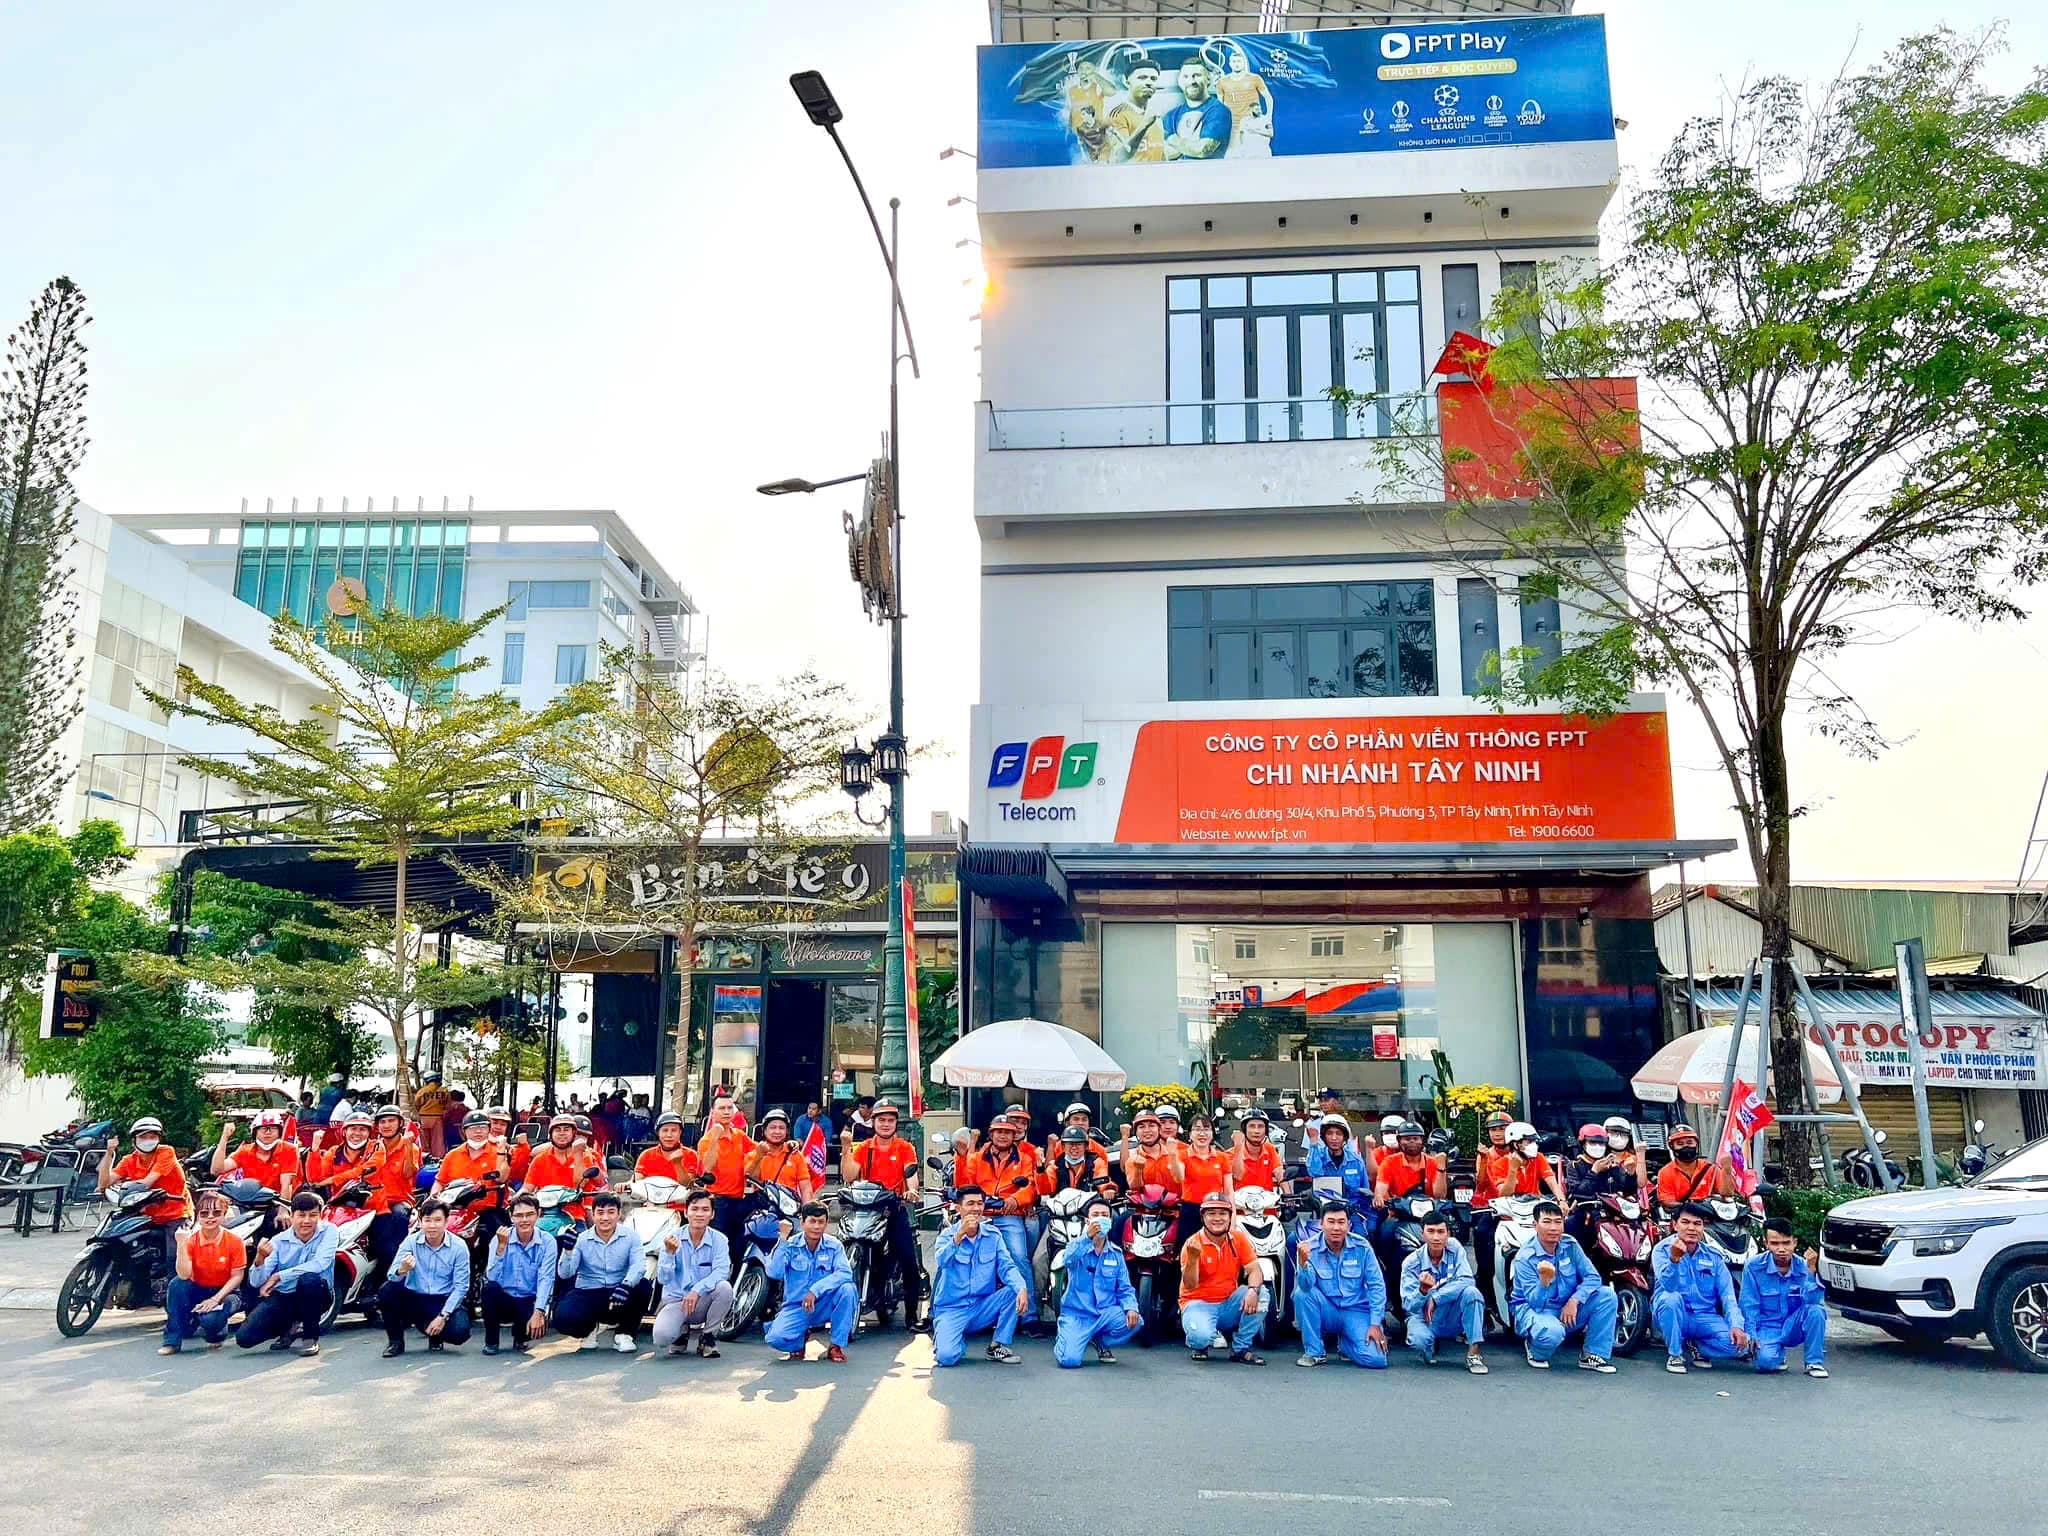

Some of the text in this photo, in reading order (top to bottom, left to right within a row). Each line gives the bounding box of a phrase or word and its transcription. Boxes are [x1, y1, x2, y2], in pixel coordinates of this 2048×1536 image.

[1414, 31, 1507, 53] FPT Play
[1420, 114, 1476, 125] CHAMPIONS
[1516, 113, 1546, 122] YOUTH
[1430, 122, 1468, 131] LEAGUE
[1205, 726, 1588, 753] CÔNG TY CỔ PHẦN VIỄN THÔNG FPT
[1246, 758, 1541, 785] CHI NHÁNH TÂY NINH
[999, 802, 1076, 821] Telecom
[1179, 807, 1199, 820] Địa
[1220, 808, 1242, 820] 476
[1245, 806, 1283, 823] đường
[1286, 806, 1314, 822] 30/4,
[1316, 806, 1340, 819] Khu
[1341, 804, 1365, 818] Phố
[1367, 806, 1376, 820] 5,
[1379, 804, 1425, 821] Phường
[1427, 806, 1437, 820] 3,
[1440, 806, 1456, 818] TP
[1459, 805, 1480, 820] Tây
[1542, 804, 1564, 819] Tây
[1567, 804, 1594, 817] Ninh
[1234, 827, 1307, 842] www.fpt.vn
[1530, 825, 1560, 838] 1900
[1561, 825, 1595, 838] 6600
[781, 941, 873, 965] Welcome
[1800, 1022, 1995, 1051] OTOCOPY
[1864, 1050, 1895, 1063] SCAN
[1896, 1065, 1905, 1077] VI
[1957, 1067, 1973, 1080] CHO
[2012, 1068, 2036, 1081] PHOTO
